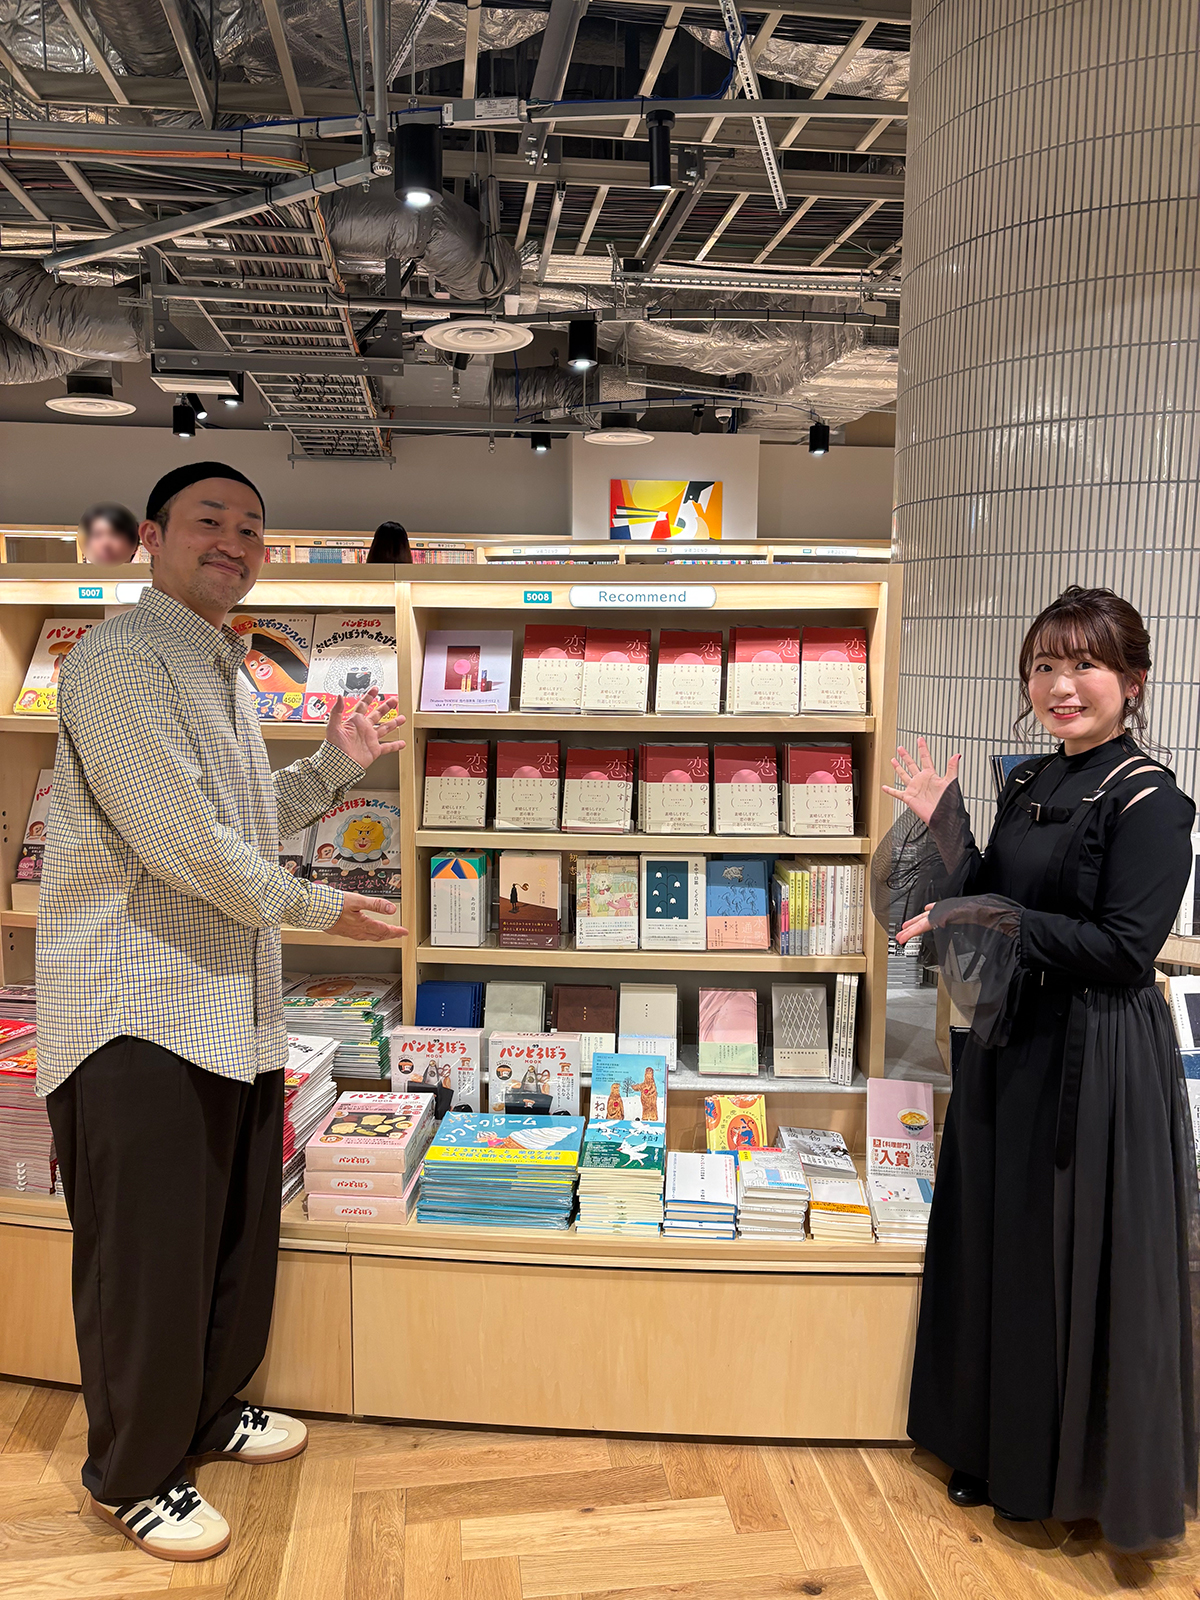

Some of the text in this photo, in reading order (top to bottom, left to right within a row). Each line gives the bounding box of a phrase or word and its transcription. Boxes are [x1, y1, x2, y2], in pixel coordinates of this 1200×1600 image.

[80, 588, 100, 598] 5007
[526, 592, 550, 602] 5008
[598, 590, 687, 603] Recommend
[341, 618, 382, 628] パンどろぼう
[401, 1039, 466, 1054] パンどろぼう
[500, 1044, 566, 1060] パンどろぼう
[879, 1150, 910, 1167] 入賞
